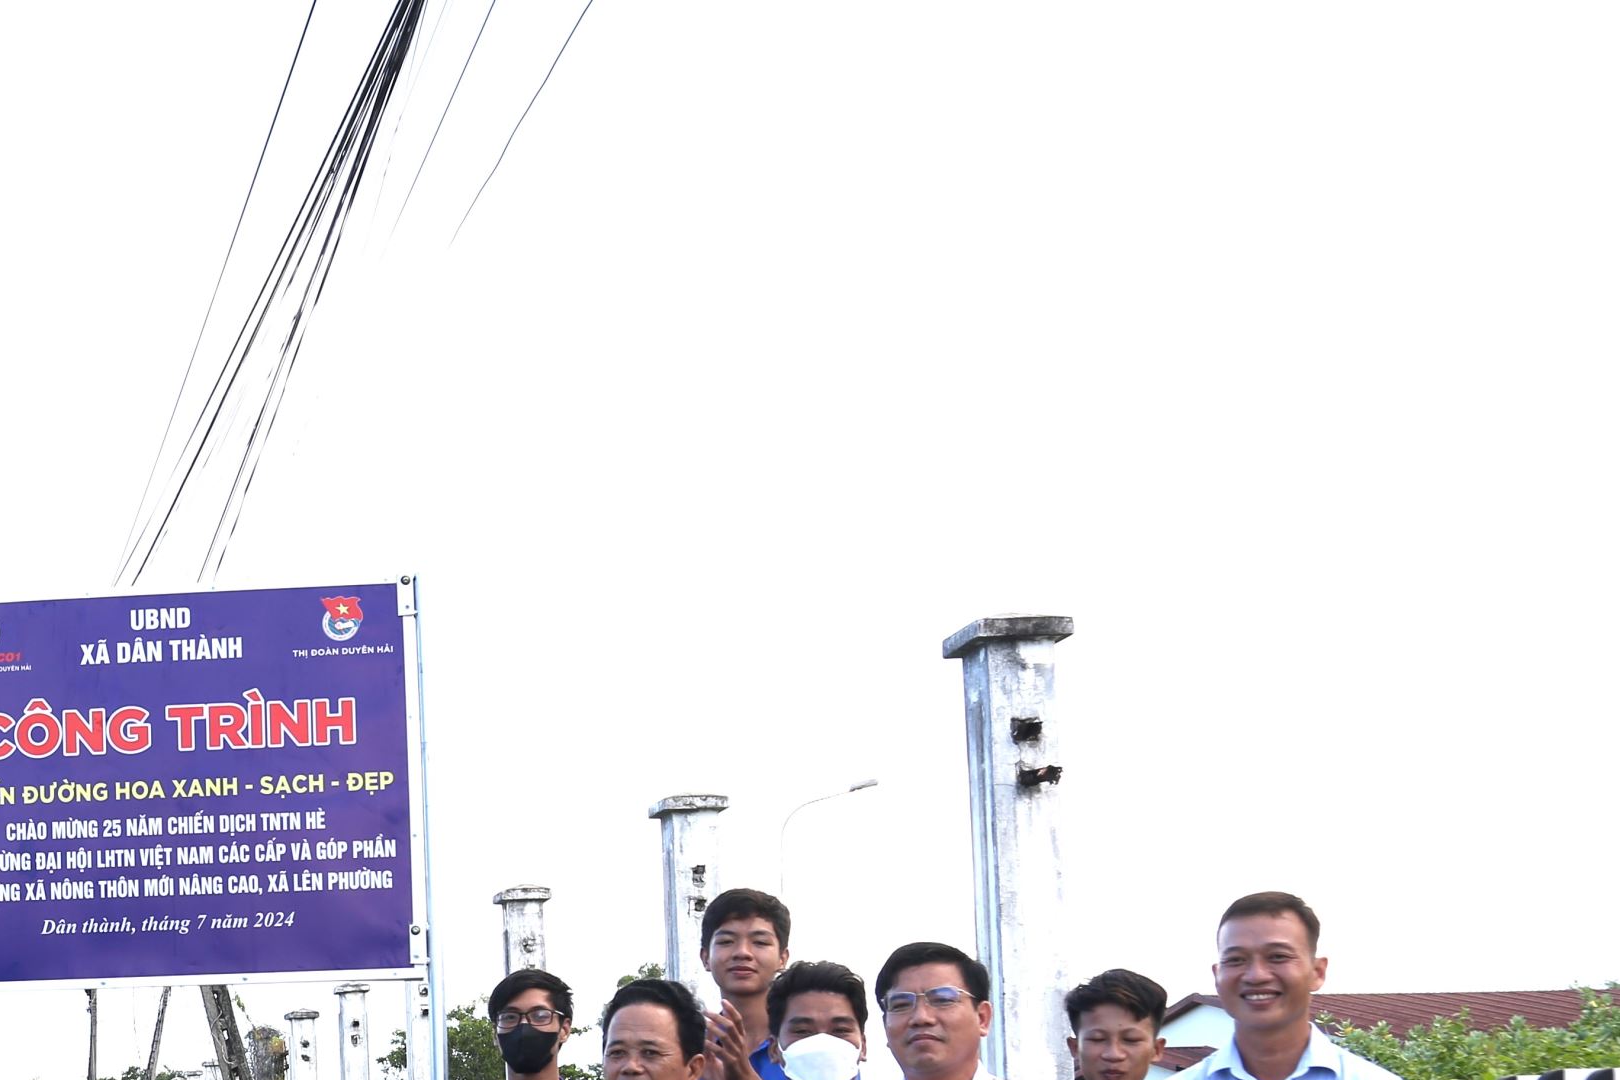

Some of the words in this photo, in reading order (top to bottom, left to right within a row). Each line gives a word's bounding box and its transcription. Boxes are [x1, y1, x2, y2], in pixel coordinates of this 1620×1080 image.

[131, 608, 190, 630] UBND
[81, 639, 110, 665] XÃ
[117, 637, 162, 663] DÂN
[169, 634, 242, 661] THÀNH
[293, 649, 308, 659] THỊ
[311, 646, 339, 657] ĐOÀN
[342, 644, 375, 655] DUYÊN
[377, 643, 394, 654] HẢI
[0, 664, 20, 673] DUYÊN
[21, 663, 32, 671] HẢI
[165, 688, 356, 751] TRÌNH
[22, 779, 107, 804] ĐƯỜNG
[116, 781, 165, 800] HOA
[172, 778, 237, 797] XANH
[260, 774, 324, 798] SẠCH
[346, 772, 393, 795] ĐẸP
[6, 819, 47, 841] CHÀO
[52, 817, 98, 839] MỪNG
[103, 820, 121, 837] 25
[126, 814, 162, 836] NĂM
[168, 810, 214, 834] CHIẾN
[219, 814, 256, 836] DỊCH
[260, 812, 301, 831] TNTN
[306, 808, 325, 829] HÈ
[36, 852, 61, 873] ĐẠI
[67, 847, 92, 872] HỘI
[97, 849, 135, 868] LHTN
[140, 844, 172, 869] VIỆT
[177, 846, 213, 865] NAM
[219, 841, 249, 863] CÁC
[255, 837, 286, 862] CẤP
[291, 839, 311, 860] VÀ
[316, 838, 347, 859] GÓP
[353, 834, 396, 858] PHẦN
[25, 880, 46, 900] XÃ
[51, 878, 93, 900] NÔNG
[98, 876, 139, 898] THÔN
[144, 875, 174, 896] MỚI
[179, 874, 223, 895] NÂNG
[228, 875, 262, 895] CAO,
[268, 871, 289, 892] XÃ
[294, 870, 323, 891] LÊN
[328, 867, 392, 890] PHƯỜNG
[41, 919, 76, 934] Dân
[82, 917, 135, 934] thành,
[142, 916, 190, 934] tháng
[198, 915, 207, 929] 7
[211, 914, 247, 928] năm
[254, 912, 294, 927] 2024
